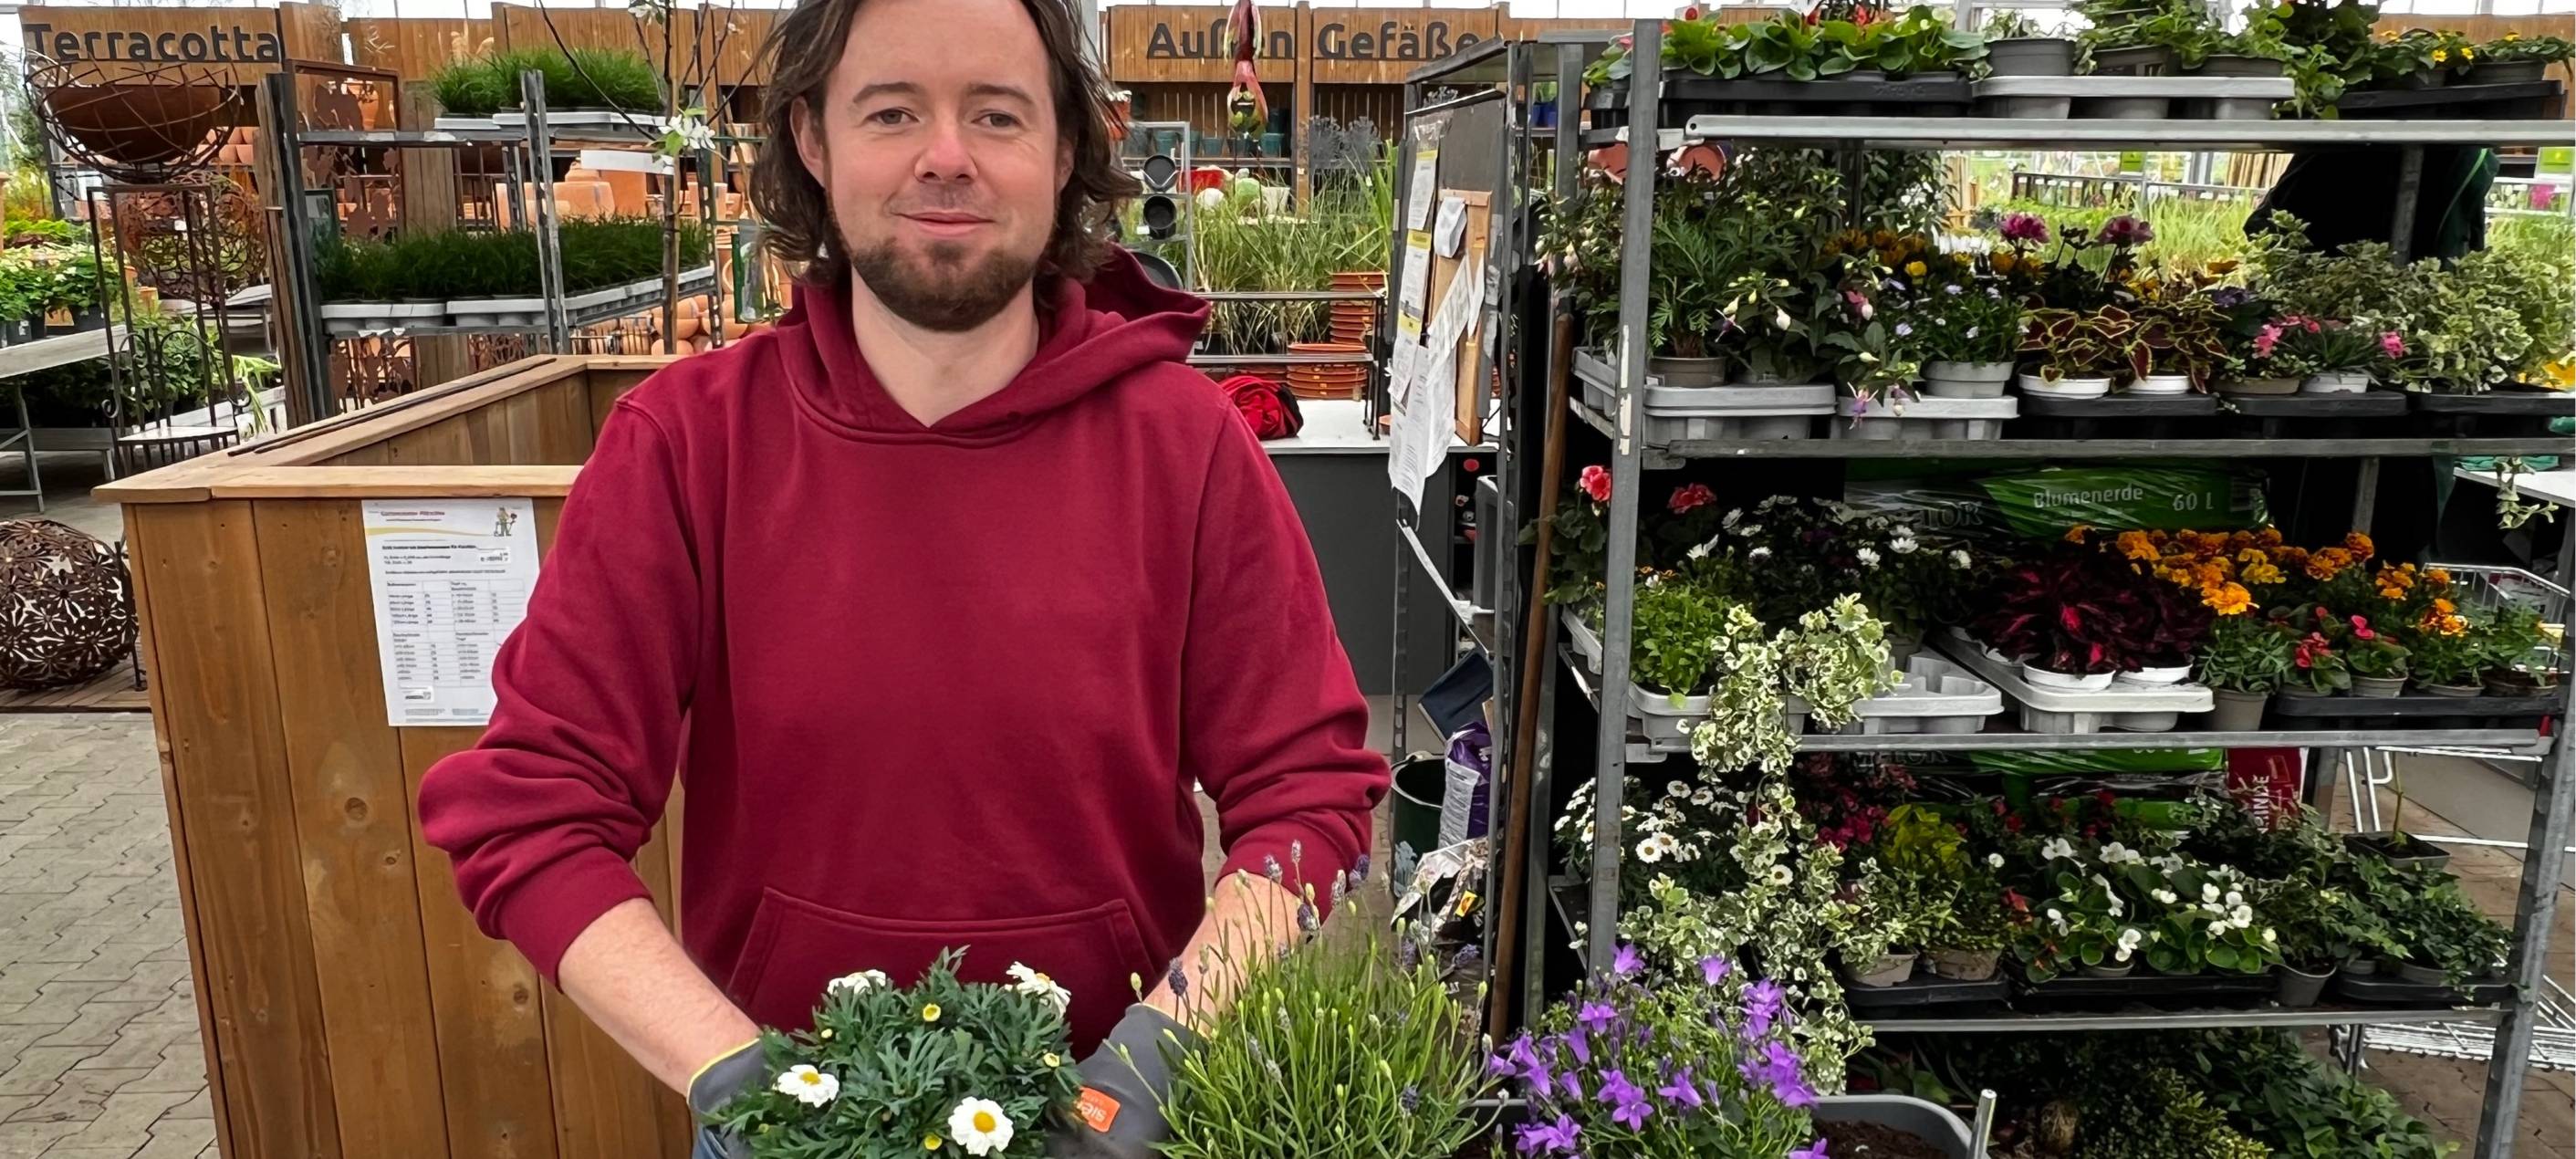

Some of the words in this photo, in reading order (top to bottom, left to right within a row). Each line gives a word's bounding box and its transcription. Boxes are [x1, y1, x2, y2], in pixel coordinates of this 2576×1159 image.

[22, 23, 280, 62] Terracotta
[1147, 18, 1294, 59] Außn
[1318, 21, 1480, 60] Gefäße
[2034, 483, 2144, 508] Blumenerde
[2173, 493, 2198, 511] 60
[2206, 492, 2215, 509] L
